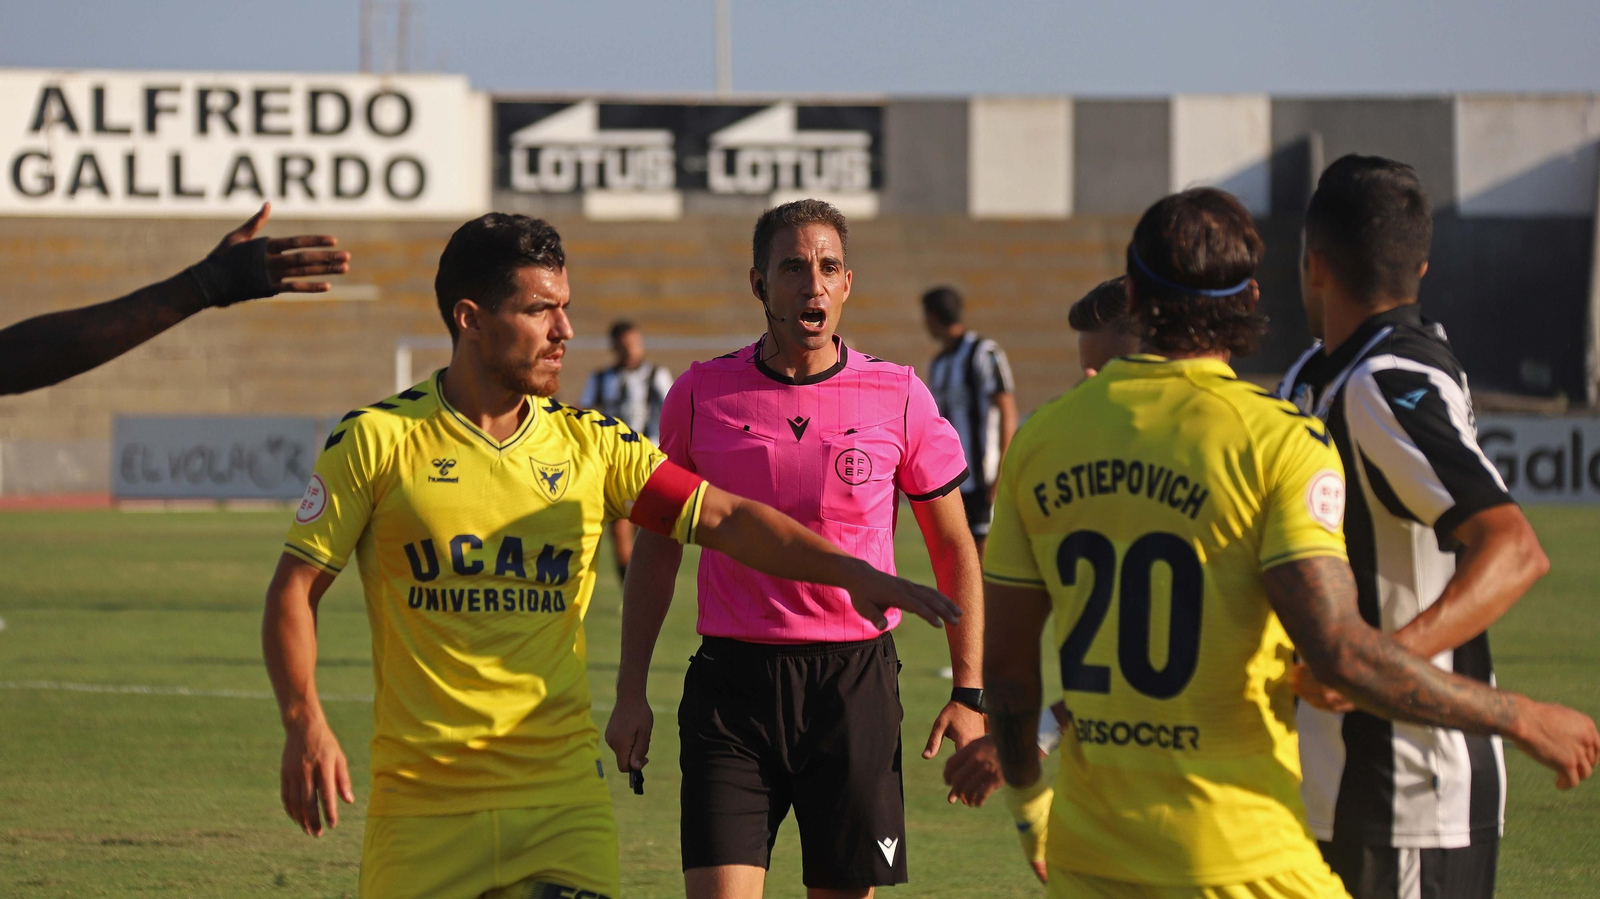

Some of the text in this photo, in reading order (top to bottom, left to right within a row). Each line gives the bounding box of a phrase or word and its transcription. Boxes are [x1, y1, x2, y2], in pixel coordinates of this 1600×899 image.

[29, 85, 415, 138] ALFREDO
[11, 151, 427, 200] GALLARDO
[510, 146, 677, 193] LOTUS
[707, 147, 872, 194] LOTUS
[428, 475, 459, 483] hummel
[1033, 459, 1209, 521] F.STIEPOVICH
[403, 534, 573, 586] UCAM
[408, 586, 566, 613] UNIVERSIDAD
[1056, 529, 1205, 700] 20
